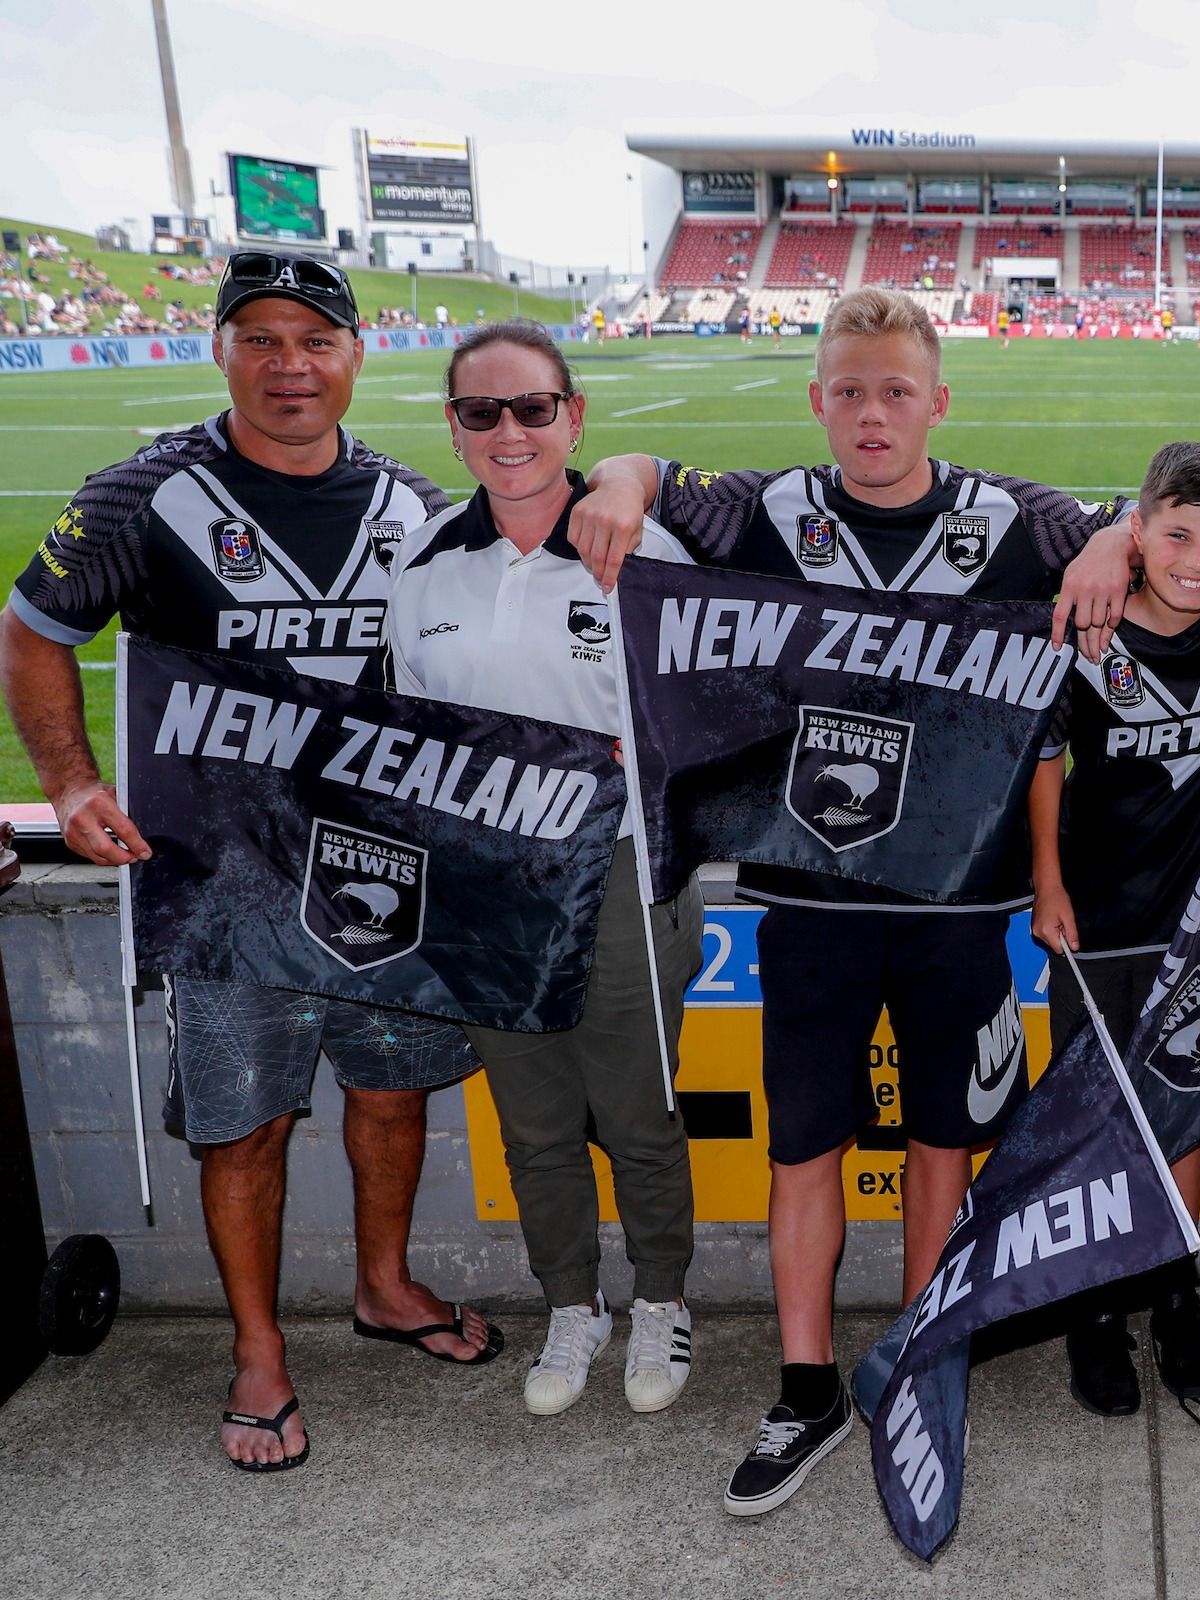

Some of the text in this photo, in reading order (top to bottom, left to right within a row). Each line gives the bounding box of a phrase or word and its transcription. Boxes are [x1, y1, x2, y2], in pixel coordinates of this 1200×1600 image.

[852, 129, 976, 148] WIN Stadium
[385, 184, 471, 203] momentum
[267, 266, 301, 289] A
[0, 342, 44, 369] NSW
[168, 338, 201, 361] NSW
[371, 528, 404, 540] KIWIS
[946, 523, 986, 535] KIWIS
[217, 607, 390, 649] PIRTE
[419, 622, 459, 640] KooGa
[571, 650, 603, 663] KIWIS
[583, 646, 607, 655] ZEALAND
[657, 597, 1074, 712] NEW ZEALAND
[808, 715, 902, 742] NEW ZEALAND
[804, 726, 900, 763] KIWIS
[153, 680, 598, 840] NEW ZEALAND
[322, 831, 418, 866] NEW ZEALAND
[318, 842, 416, 886] KIWIS
[977, 976, 1022, 1081] NIK
[993, 1170, 1133, 1280] NEW
